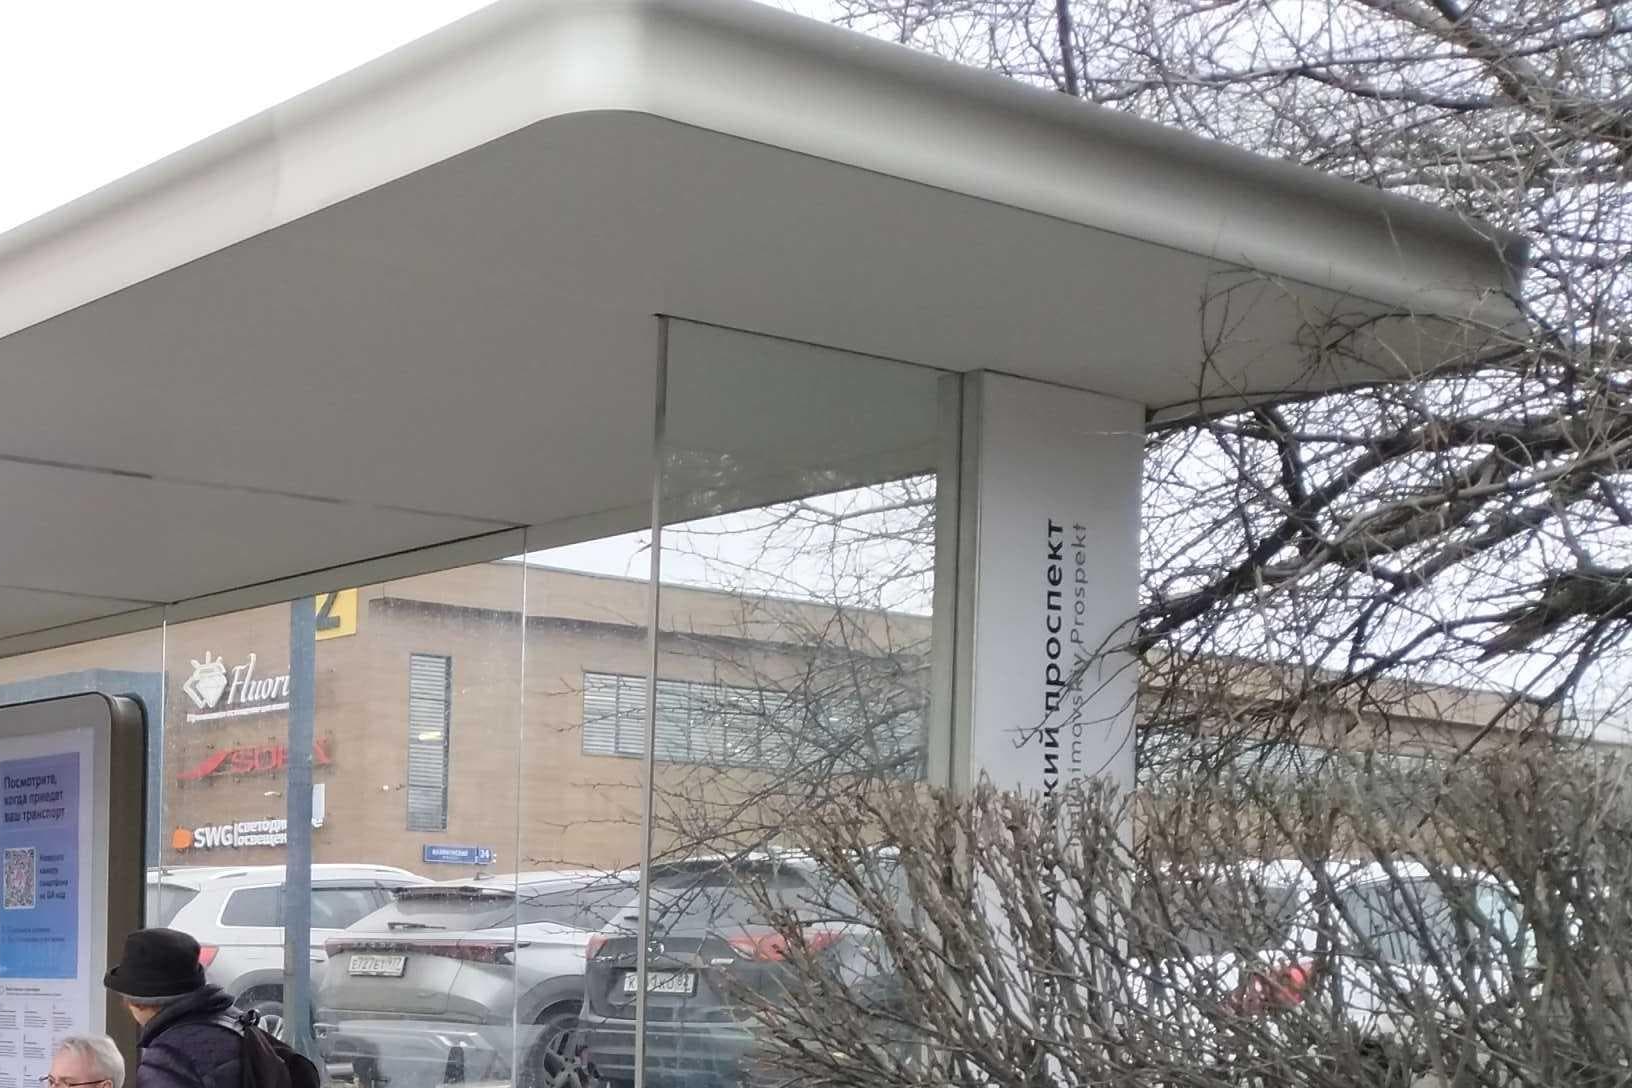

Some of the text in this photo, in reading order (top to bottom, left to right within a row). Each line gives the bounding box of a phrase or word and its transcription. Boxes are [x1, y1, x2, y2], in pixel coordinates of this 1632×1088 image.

[1044, 518, 1067, 712] проспект
[1070, 520, 1089, 644] Prospekt
[193, 824, 234, 849] SWG
